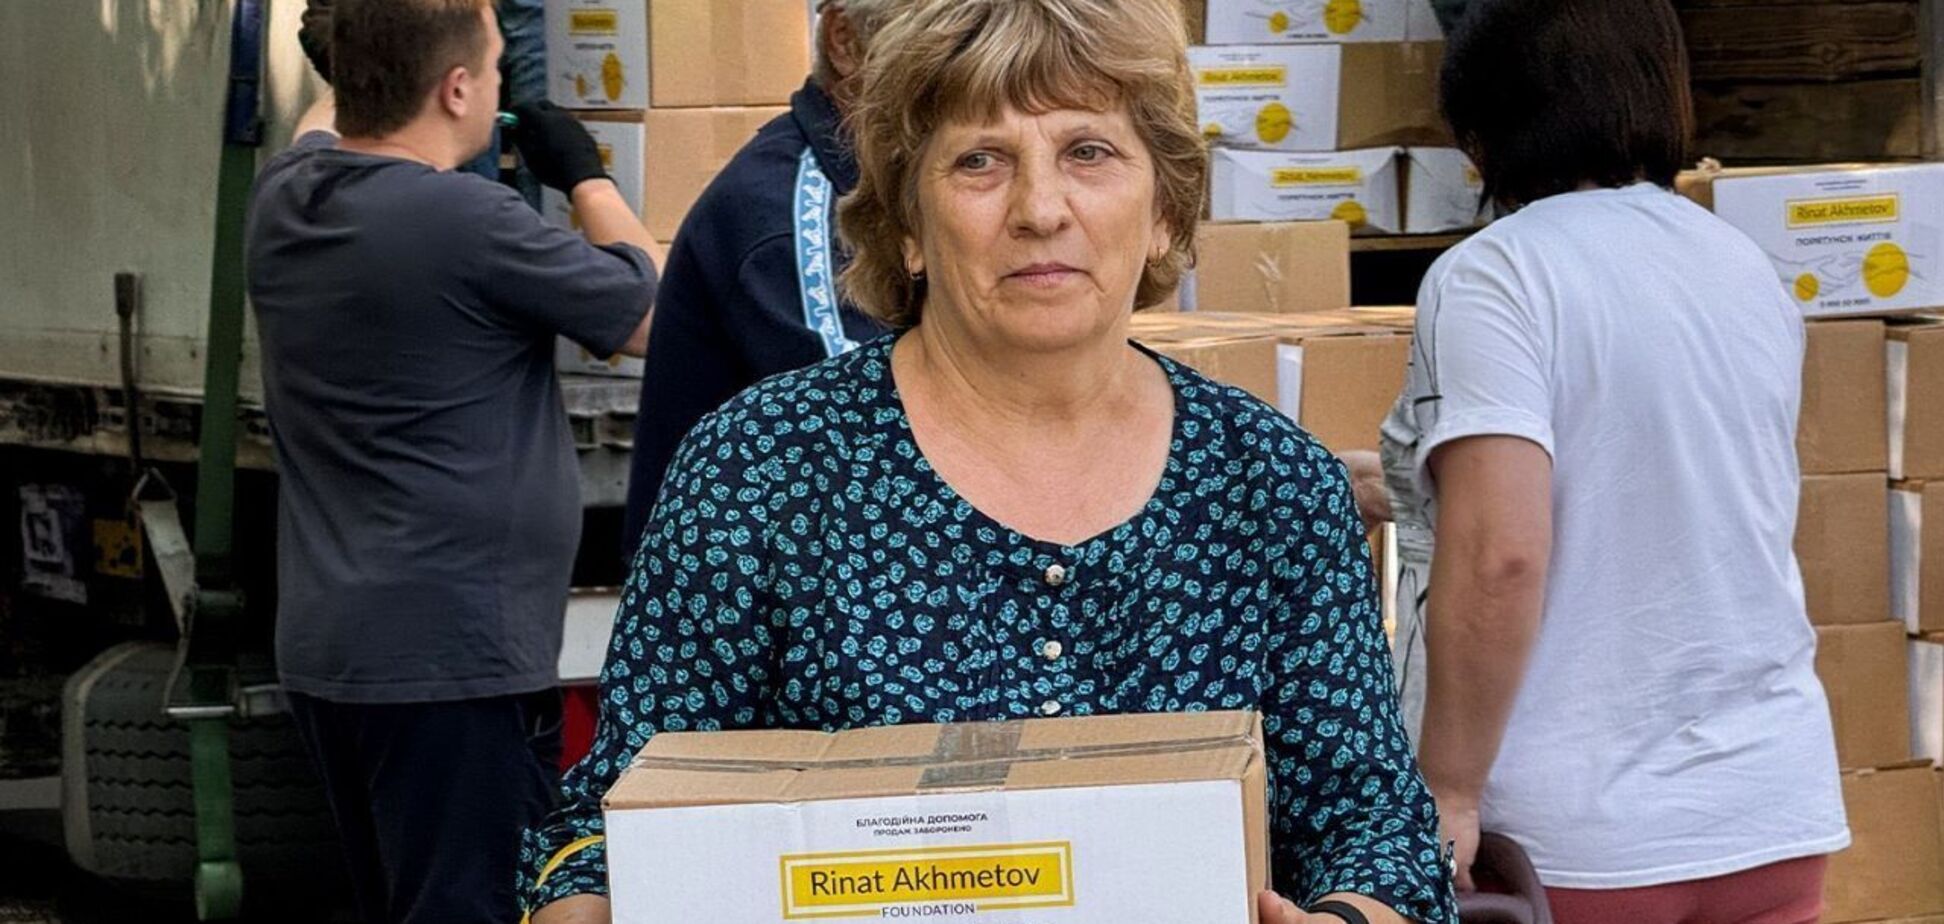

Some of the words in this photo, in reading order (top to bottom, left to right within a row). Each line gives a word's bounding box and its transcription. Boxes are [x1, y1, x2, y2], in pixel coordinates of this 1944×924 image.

[1797, 205, 1827, 220] Rinat
[1830, 202, 1888, 217] Akhmetov
[856, 815, 925, 828] БЛАГОДІЙНА
[927, 812, 989, 825] ДОПОМОГА
[873, 828, 911, 837] ПРОДАЖ
[914, 825, 972, 835] ЗАБОРОНЕНО
[810, 868, 884, 896] Rinat
[892, 863, 1041, 892] Akhmetov
[881, 903, 976, 918] FOUNDATION
